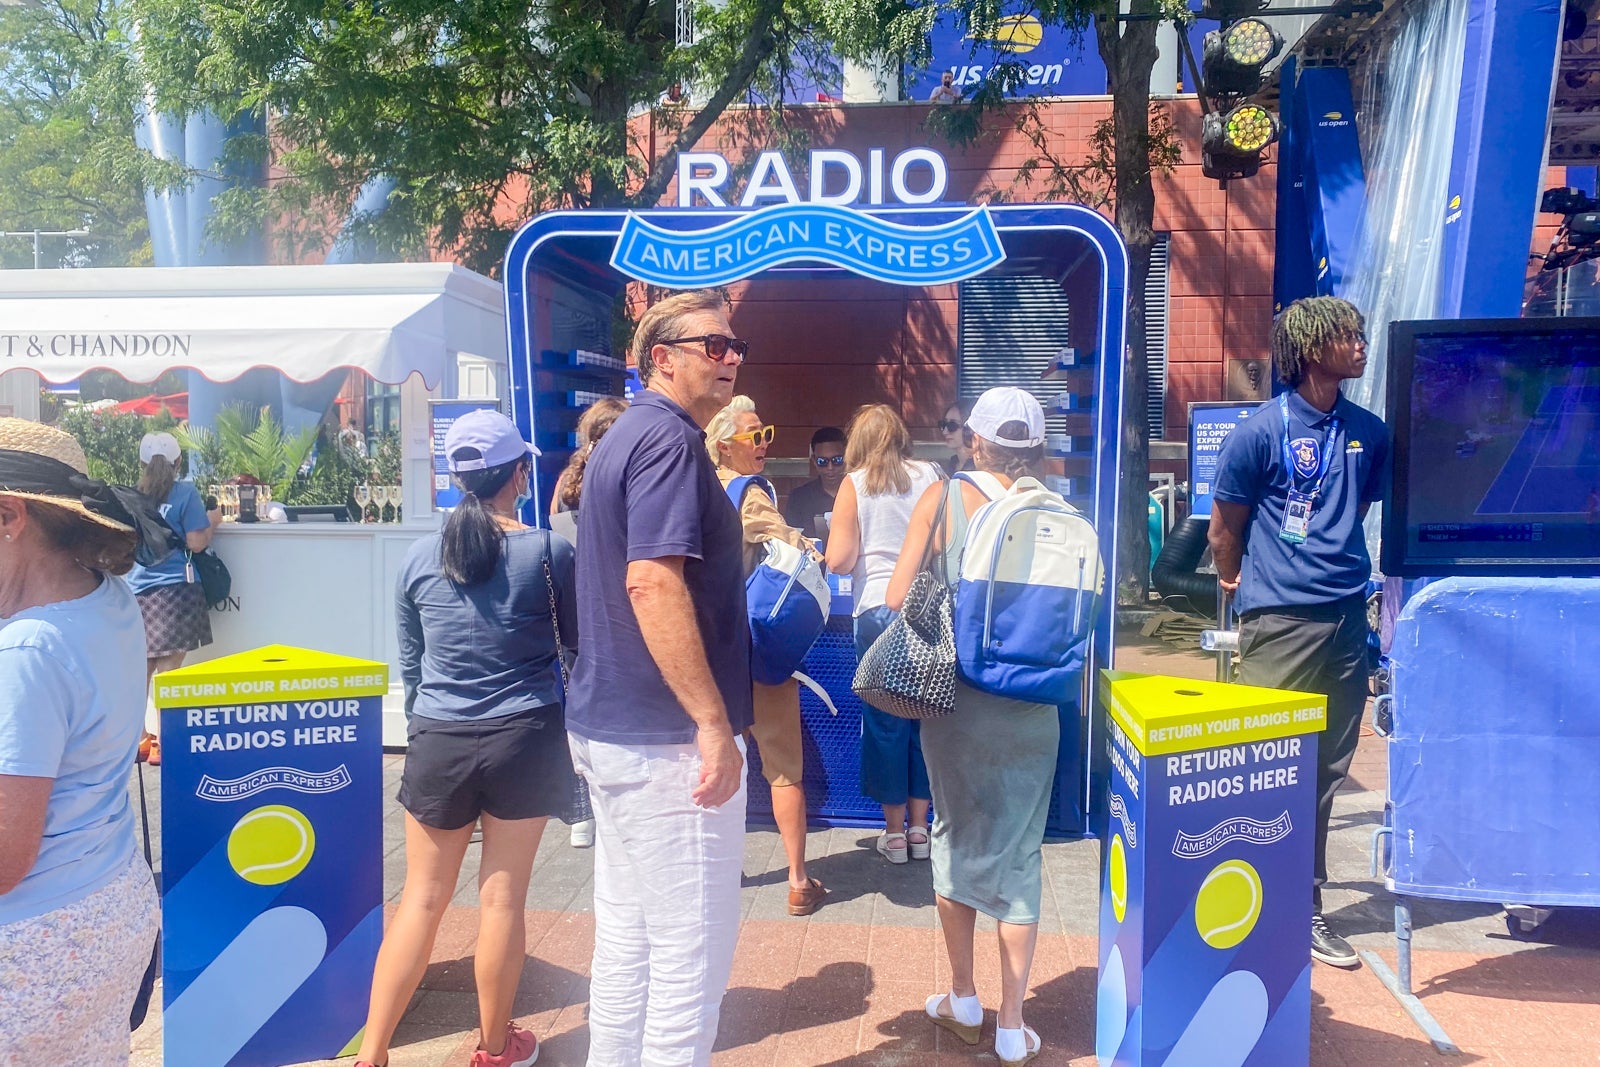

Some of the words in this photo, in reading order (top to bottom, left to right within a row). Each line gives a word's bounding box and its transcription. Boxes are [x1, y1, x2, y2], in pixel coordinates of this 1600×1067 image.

[951, 65, 983, 86] us
[678, 148, 948, 207] RADIO
[640, 220, 810, 272] AMERICAN
[825, 222, 972, 268] EXPRESS
[26, 335, 45, 358] &
[50, 334, 192, 357] CHANDON
[159, 684, 226, 698] RETURN
[230, 680, 275, 695] YOUR
[279, 676, 339, 692] RADIOS
[343, 674, 384, 688] HERE
[186, 703, 288, 727] RETURN
[294, 700, 360, 720] YOUR
[1150, 723, 1203, 743] RETURN
[1206, 718, 1241, 734] YOUR
[1244, 711, 1290, 729] RADIOS
[1293, 707, 1324, 722] HERE
[190, 729, 287, 754] RADIOS
[294, 725, 357, 746] HERE
[1166, 746, 1246, 777] RETURN
[1250, 738, 1301, 763] YOUR
[208, 773, 279, 796] AMERICAN
[283, 774, 340, 788] EXPRESS
[1169, 775, 1245, 806] RADIOS
[1250, 766, 1299, 792] HERE
[1181, 824, 1237, 852] AMERICAN
[1240, 823, 1284, 838] EXPRESS
